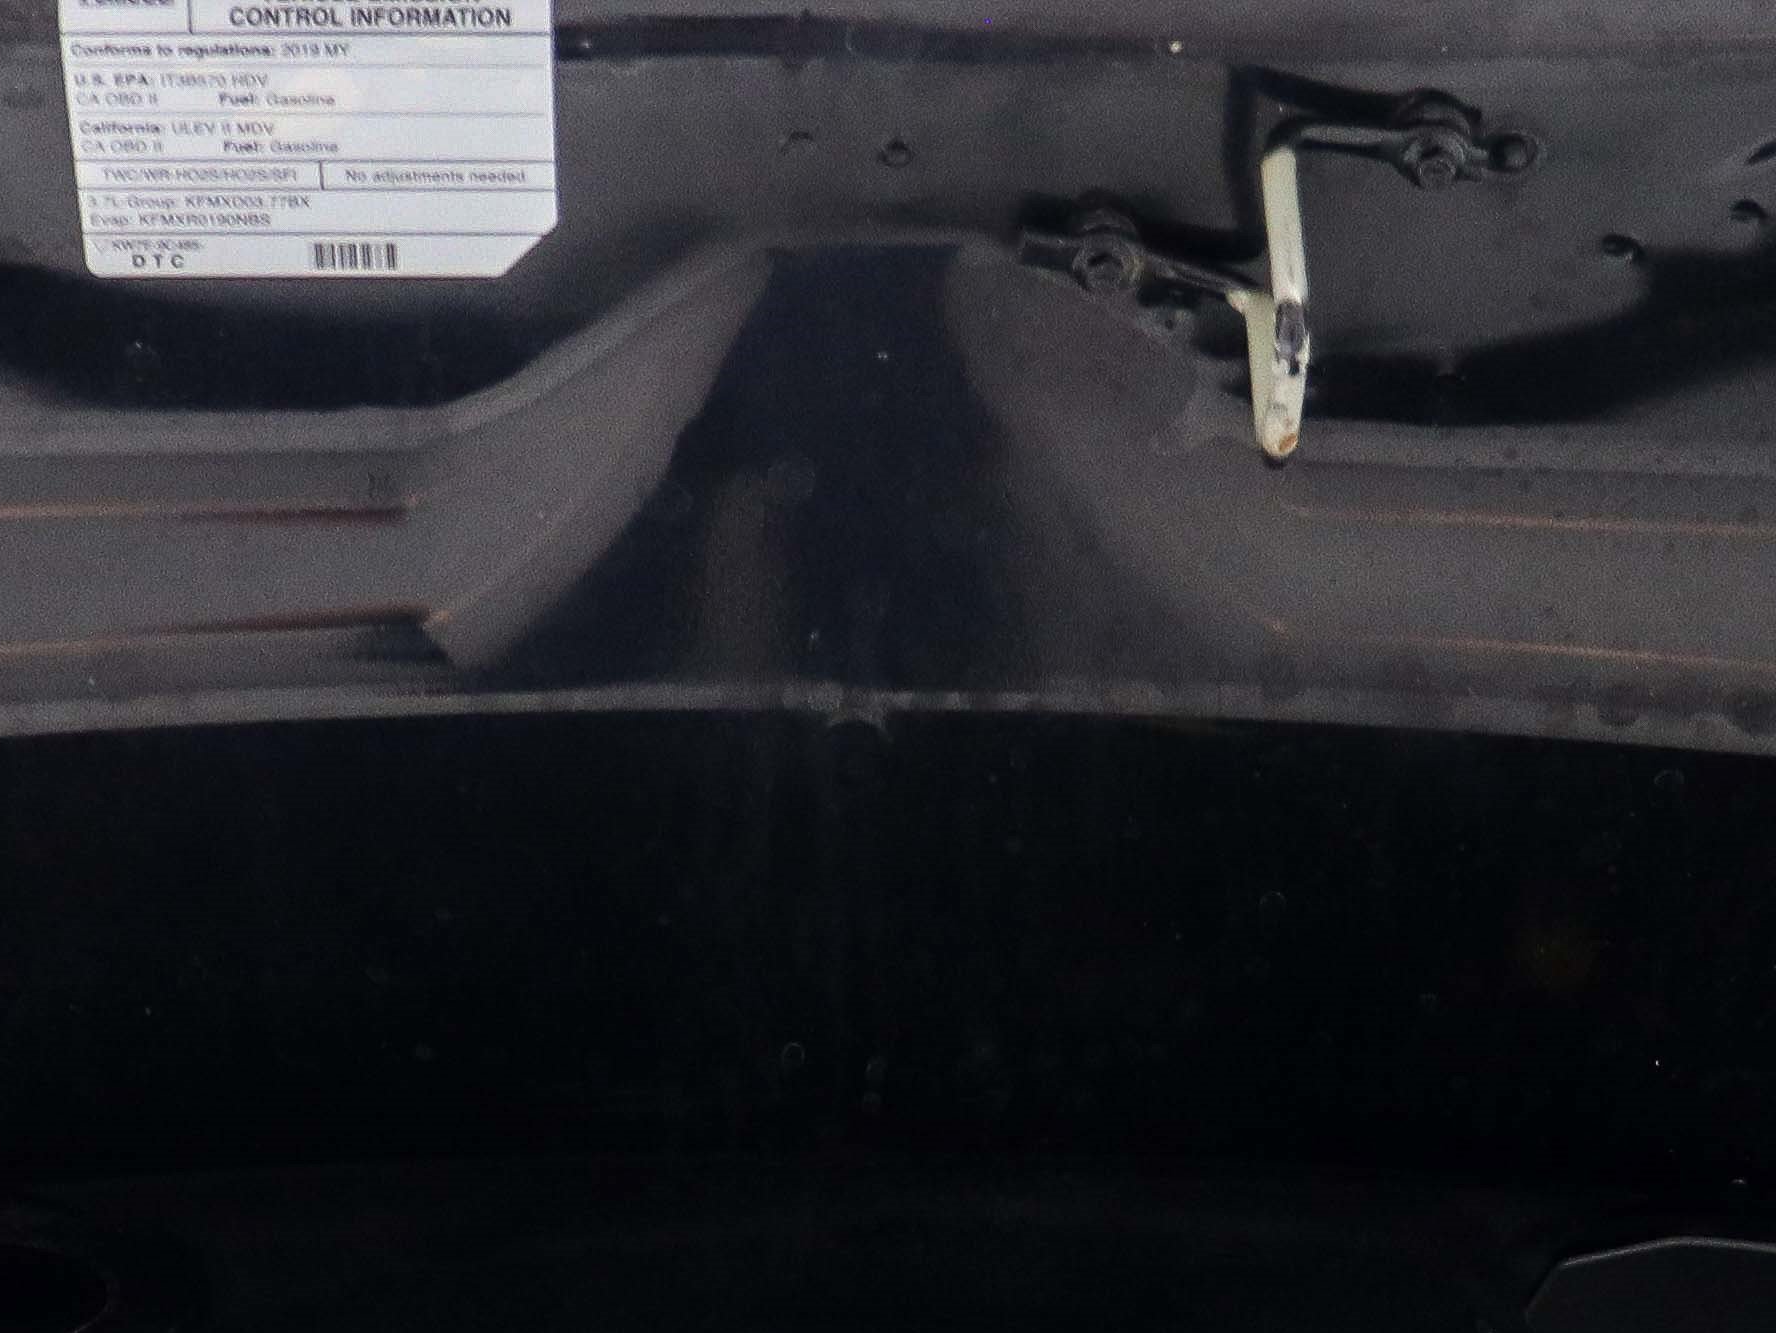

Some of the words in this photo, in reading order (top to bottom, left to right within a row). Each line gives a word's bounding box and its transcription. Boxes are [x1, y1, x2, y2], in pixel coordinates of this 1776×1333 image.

[229, 7, 343, 27] CONTROL
[351, 7, 513, 27] INFORMATION
[71, 42, 152, 57] Conforms
[156, 43, 174, 57] to
[177, 42, 273, 60] regulations:
[218, 92, 257, 106] Fuel:
[266, 93, 336, 107] Gasoline
[79, 121, 163, 136] California:
[223, 139, 262, 153] Fuel:
[270, 140, 339, 154] Gasoline
[345, 169, 364, 182] No
[374, 168, 465, 184] adjustments
[470, 169, 525, 183] needed
